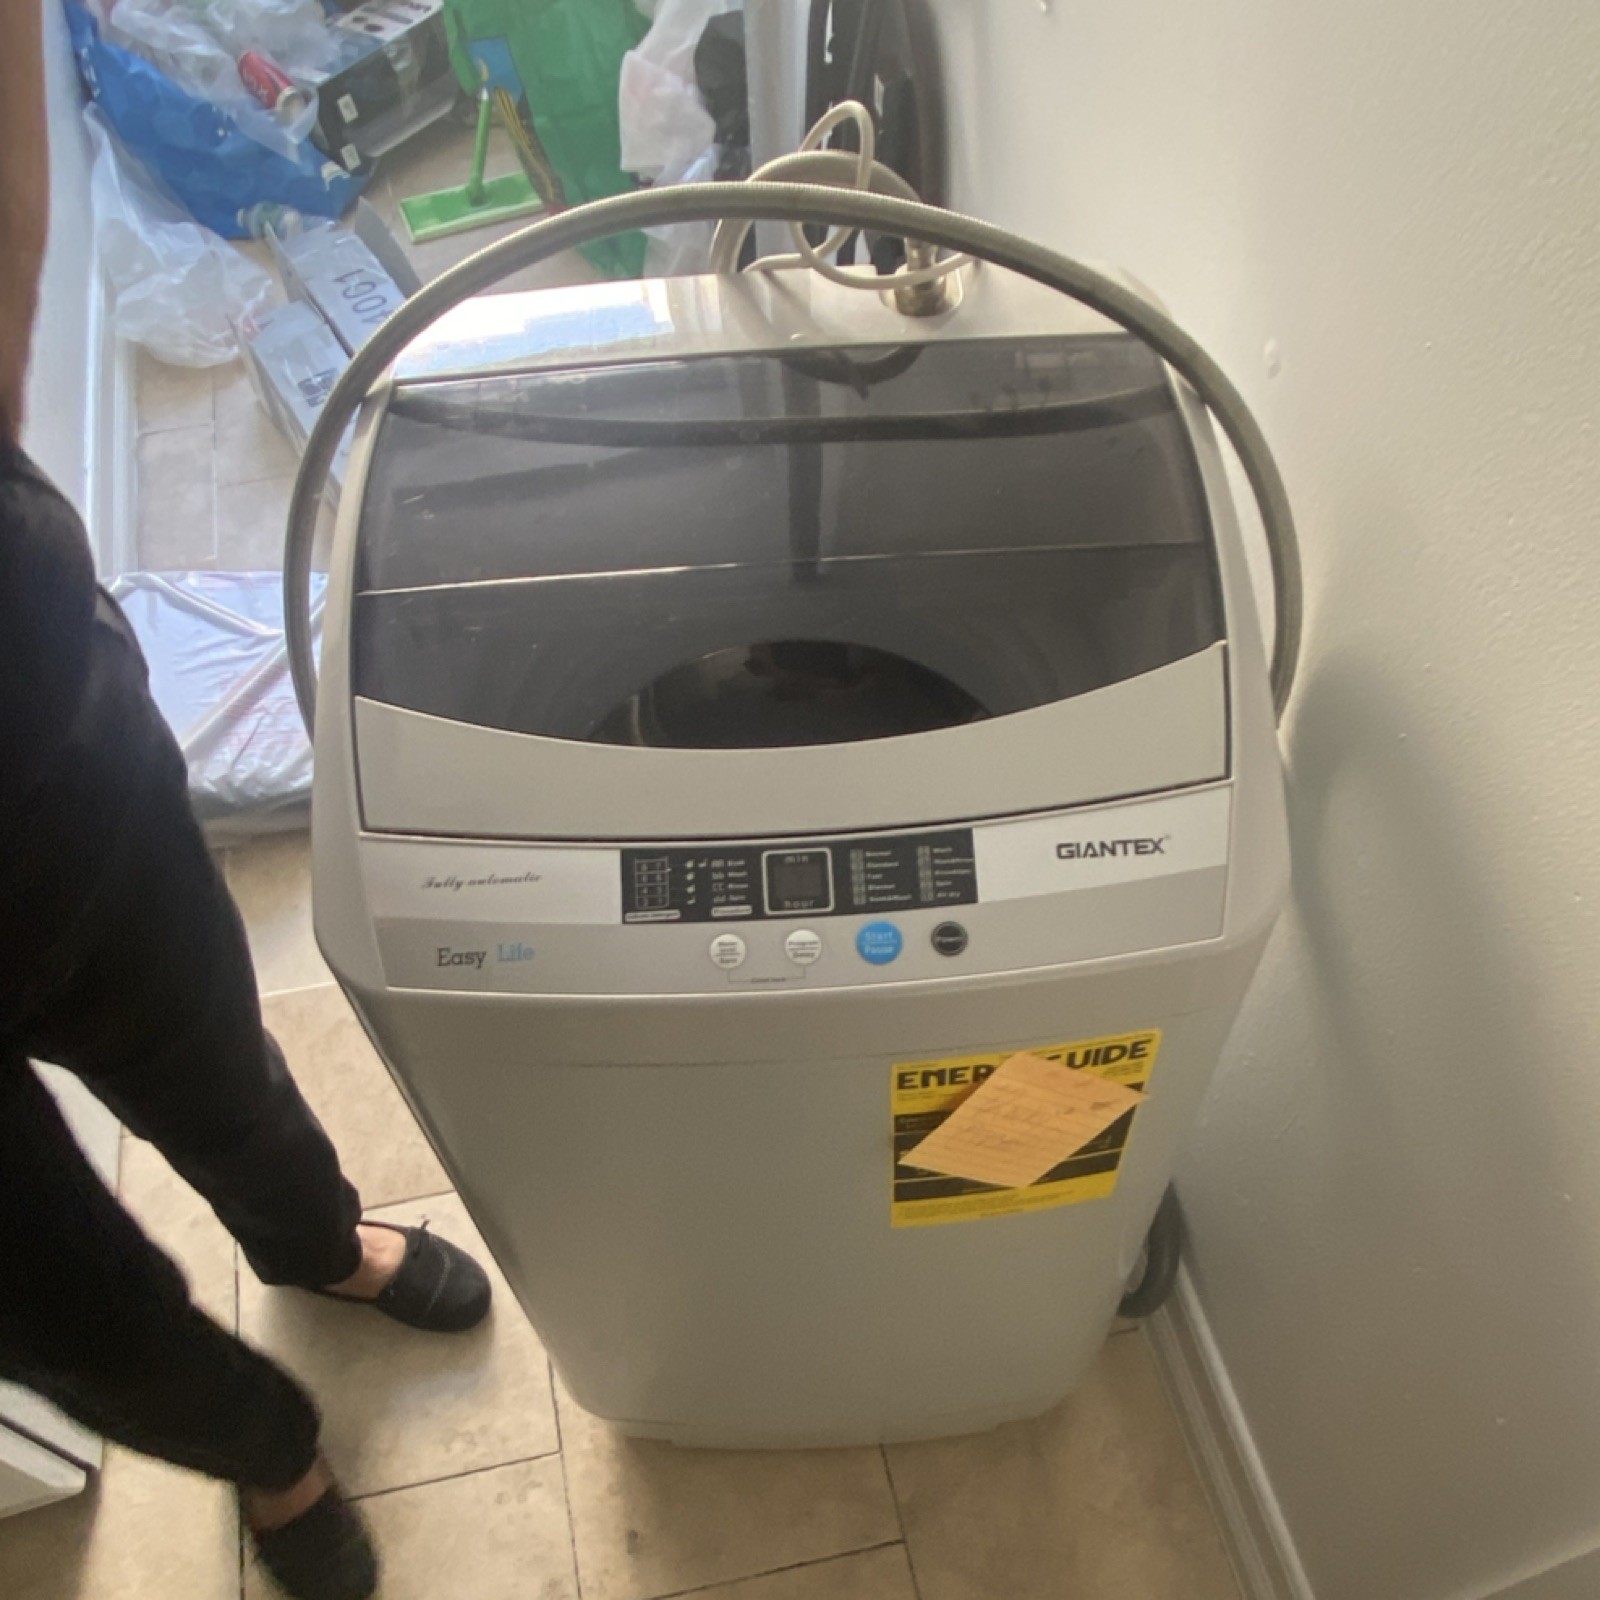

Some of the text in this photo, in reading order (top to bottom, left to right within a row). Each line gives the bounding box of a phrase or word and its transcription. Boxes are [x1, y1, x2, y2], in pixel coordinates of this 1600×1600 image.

[1056, 838, 1165, 860] GIANTEX
[437, 942, 536, 970] Easy Life
